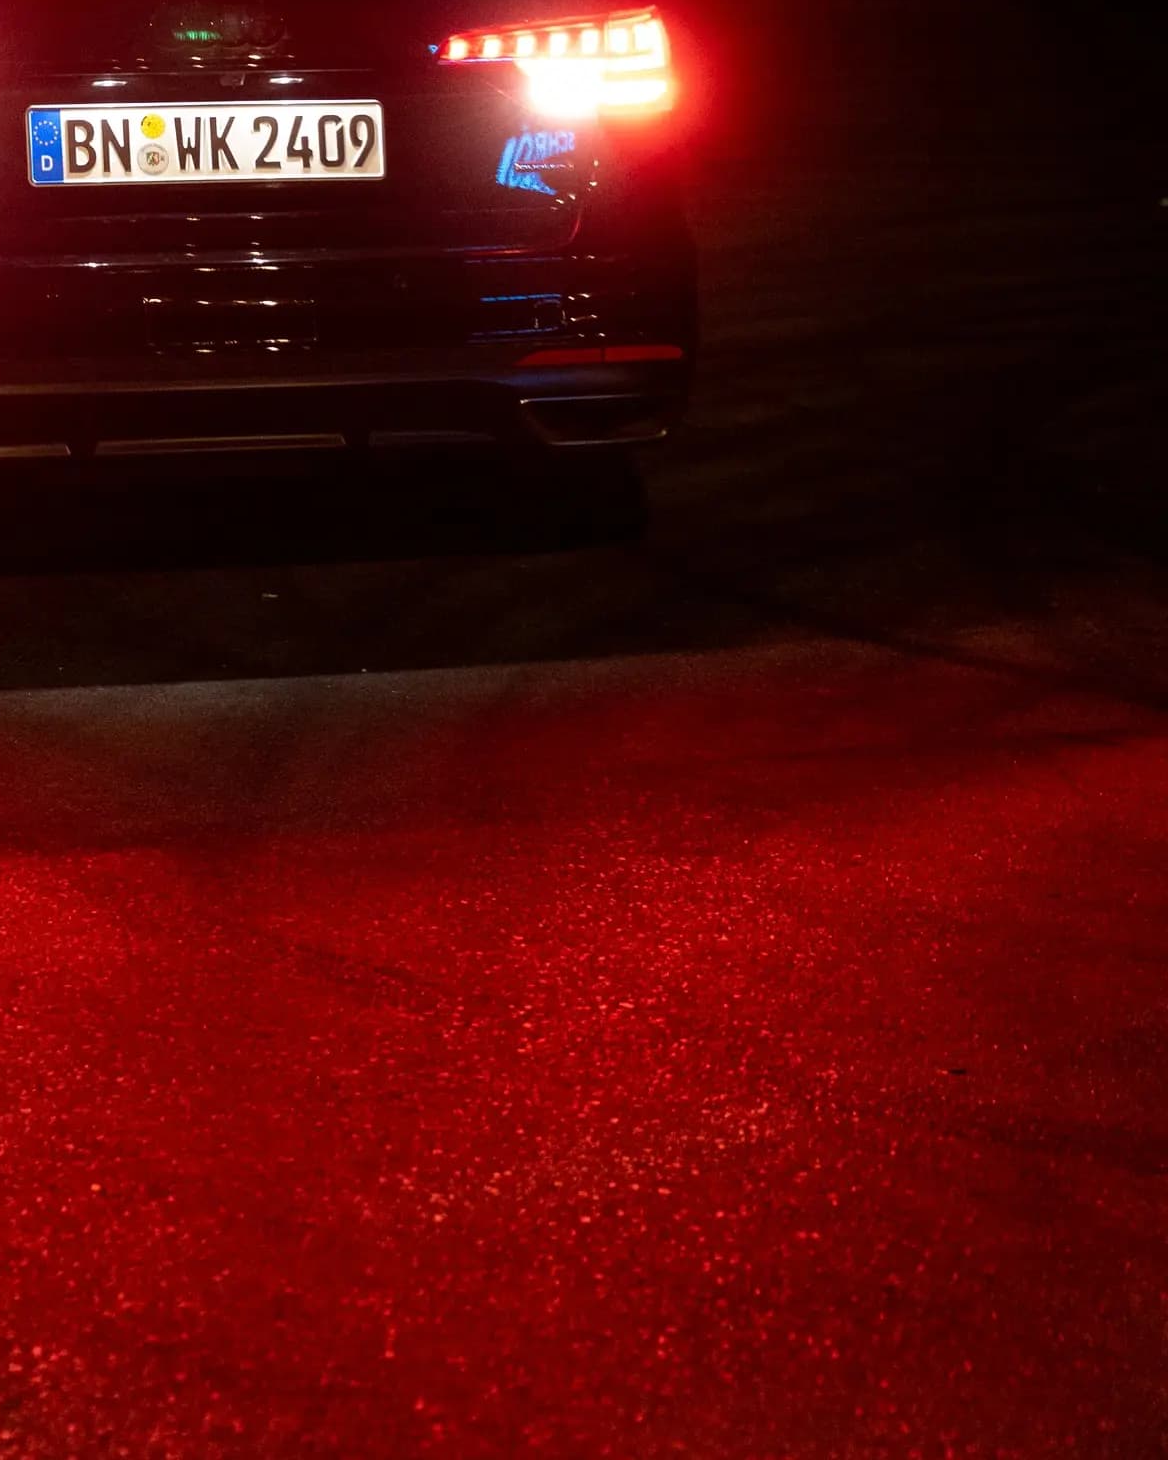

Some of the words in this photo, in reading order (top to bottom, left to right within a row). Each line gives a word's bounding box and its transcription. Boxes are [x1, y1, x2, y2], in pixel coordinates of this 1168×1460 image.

[66, 118, 132, 173] BN
[174, 116, 240, 171] WK
[252, 113, 376, 169] 2409
[41, 155, 54, 172] D
